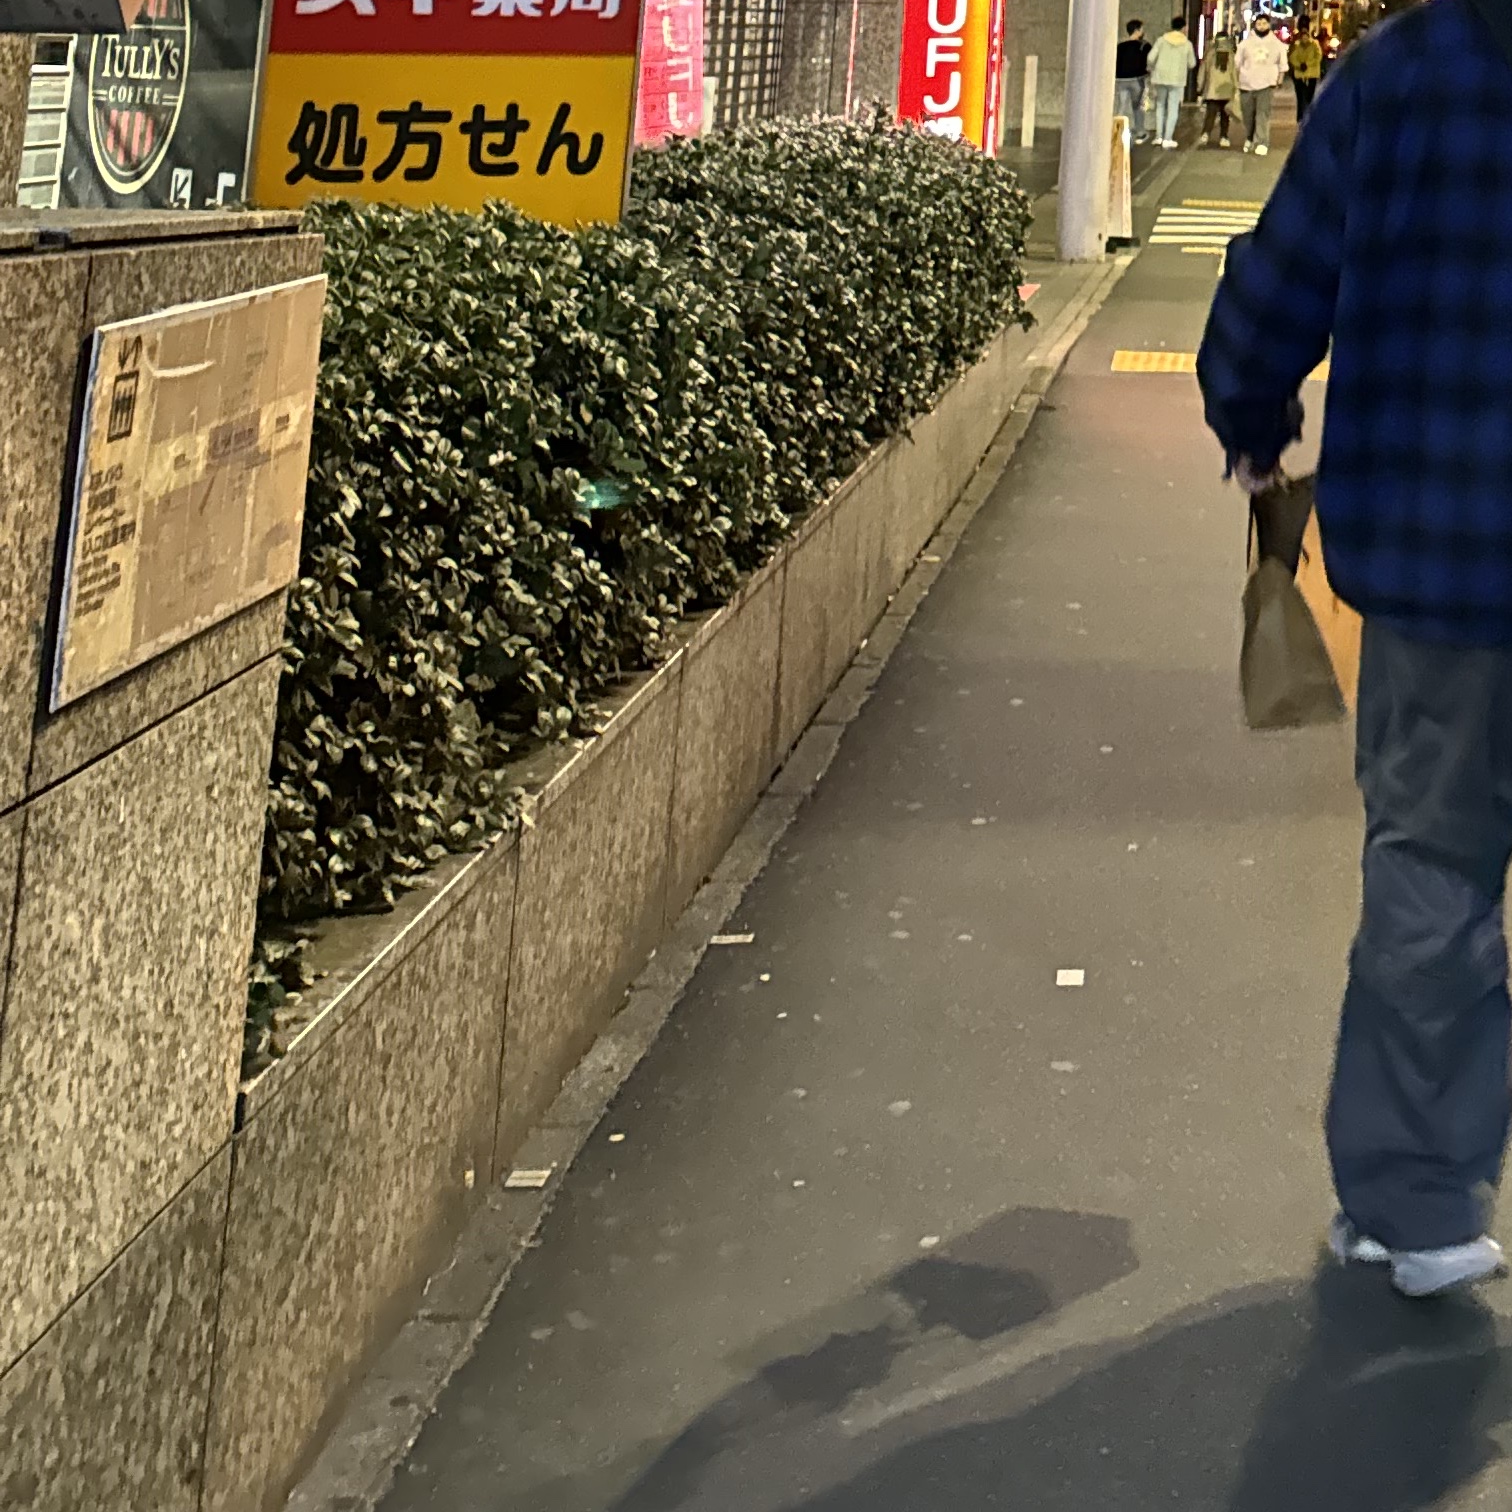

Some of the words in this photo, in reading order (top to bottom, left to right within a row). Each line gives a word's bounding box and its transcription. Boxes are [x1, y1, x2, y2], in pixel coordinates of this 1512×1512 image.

[107, 85, 161, 105] COFFEE
[285, 100, 604, 186] 処方せん
